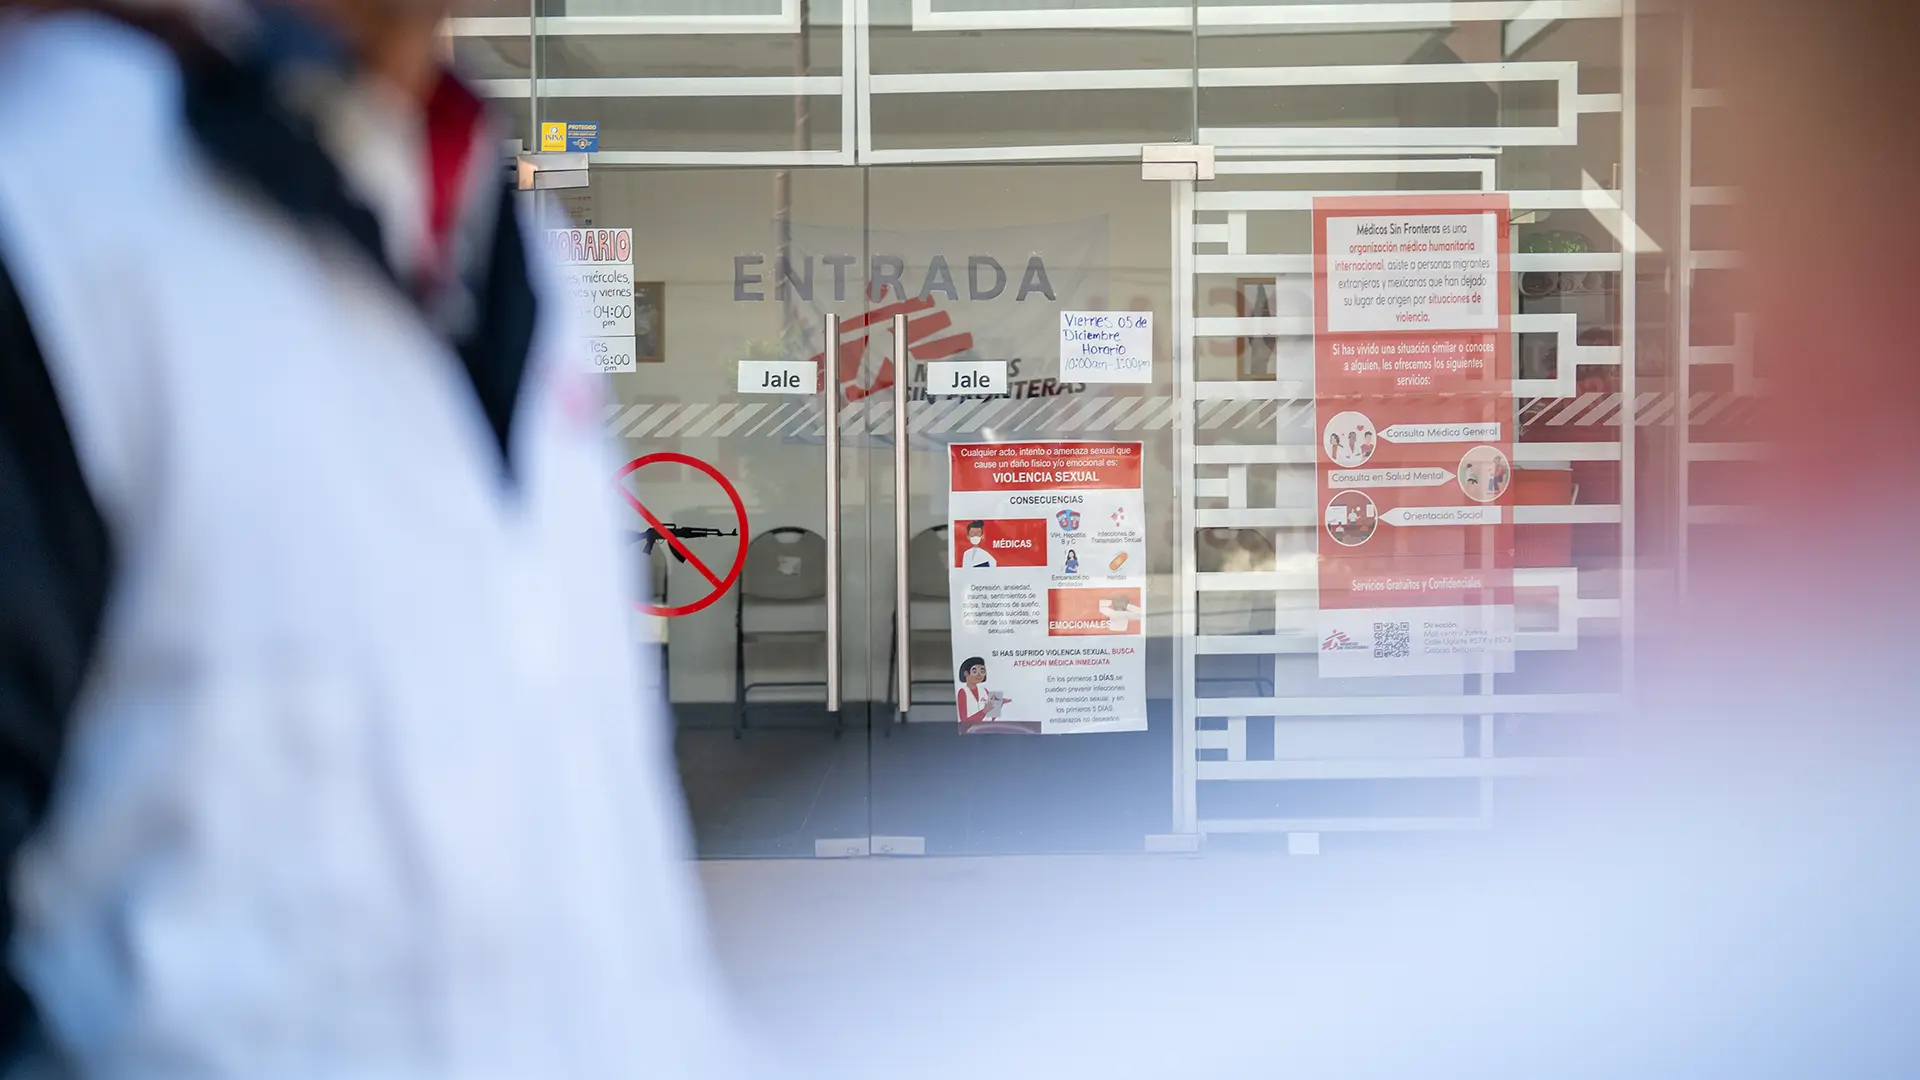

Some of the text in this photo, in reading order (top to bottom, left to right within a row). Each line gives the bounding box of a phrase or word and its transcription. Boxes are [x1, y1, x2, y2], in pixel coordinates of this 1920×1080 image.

[1356, 223, 1388, 235] Médicos
[1390, 222, 1402, 234] Sin
[1404, 222, 1440, 234] Fronteras
[1442, 226, 1451, 234] es
[1349, 239, 1475, 255] organización médica humanitaria
[1388, 260, 1408, 270] asiste
[1418, 260, 1451, 272] personas
[1453, 258, 1490, 271] migrantes
[582, 270, 631, 285] miércoles,
[733, 254, 1057, 302] ENTRADA
[1382, 280, 1386, 290] y
[1428, 278, 1443, 289] que
[1445, 274, 1459, 287] han
[1460, 274, 1487, 289] dejado
[591, 288, 632, 302] y viernes
[1344, 292, 1482, 308] su lugar de origen por situaciones de
[593, 304, 632, 318] 04:00
[1396, 311, 1430, 323] violencia.
[602, 320, 616, 329] pm
[1064, 314, 1148, 328] Viernes 05 de
[1062, 329, 1121, 342] Diciembre
[1082, 343, 1126, 356] Horario
[1332, 341, 1494, 356] Si has vivido una situación similar o conoces
[594, 354, 631, 367] 06:00
[1351, 360, 1380, 374] alguien,
[1382, 359, 1392, 370] les
[1394, 358, 1432, 370] ofrecemos
[1434, 358, 1444, 369] los
[1446, 358, 1483, 372] siguientes
[762, 370, 801, 388] Jale
[952, 370, 990, 388] Jale
[1397, 374, 1431, 386] servicios:
[1386, 427, 1498, 438] Consulta Médica General
[960, 448, 997, 458] Cualquier
[998, 448, 1018, 458] acto,
[1019, 448, 1045, 456] intento
[1090, 446, 1114, 455] sexual
[1116, 448, 1131, 457] que
[1010, 459, 1030, 468] daño
[1031, 458, 1050, 468] físico
[1052, 459, 1064, 469] y/o
[1066, 458, 1105, 467] emocional
[1106, 459, 1118, 467] es:
[992, 471, 1100, 484] VIOLENCIA SEXUAL
[1331, 473, 1370, 482] Consulta
[1386, 471, 1410, 481] Salud
[1413, 471, 1444, 480] Mental
[1010, 496, 1084, 504] CONSECUENCIAS
[1403, 510, 1483, 521] Orientación Social
[992, 538, 1032, 548] MÉDICAS
[1352, 576, 1482, 592] Servicios Gratuitos y Confidenciales
[1049, 620, 1112, 630] EMOCIONALES
[1014, 658, 1047, 667] ATENCIÓN
[1048, 658, 1074, 666] MÉDICA
[1066, 675, 1092, 683] primeros
[1066, 706, 1092, 714] primeros
